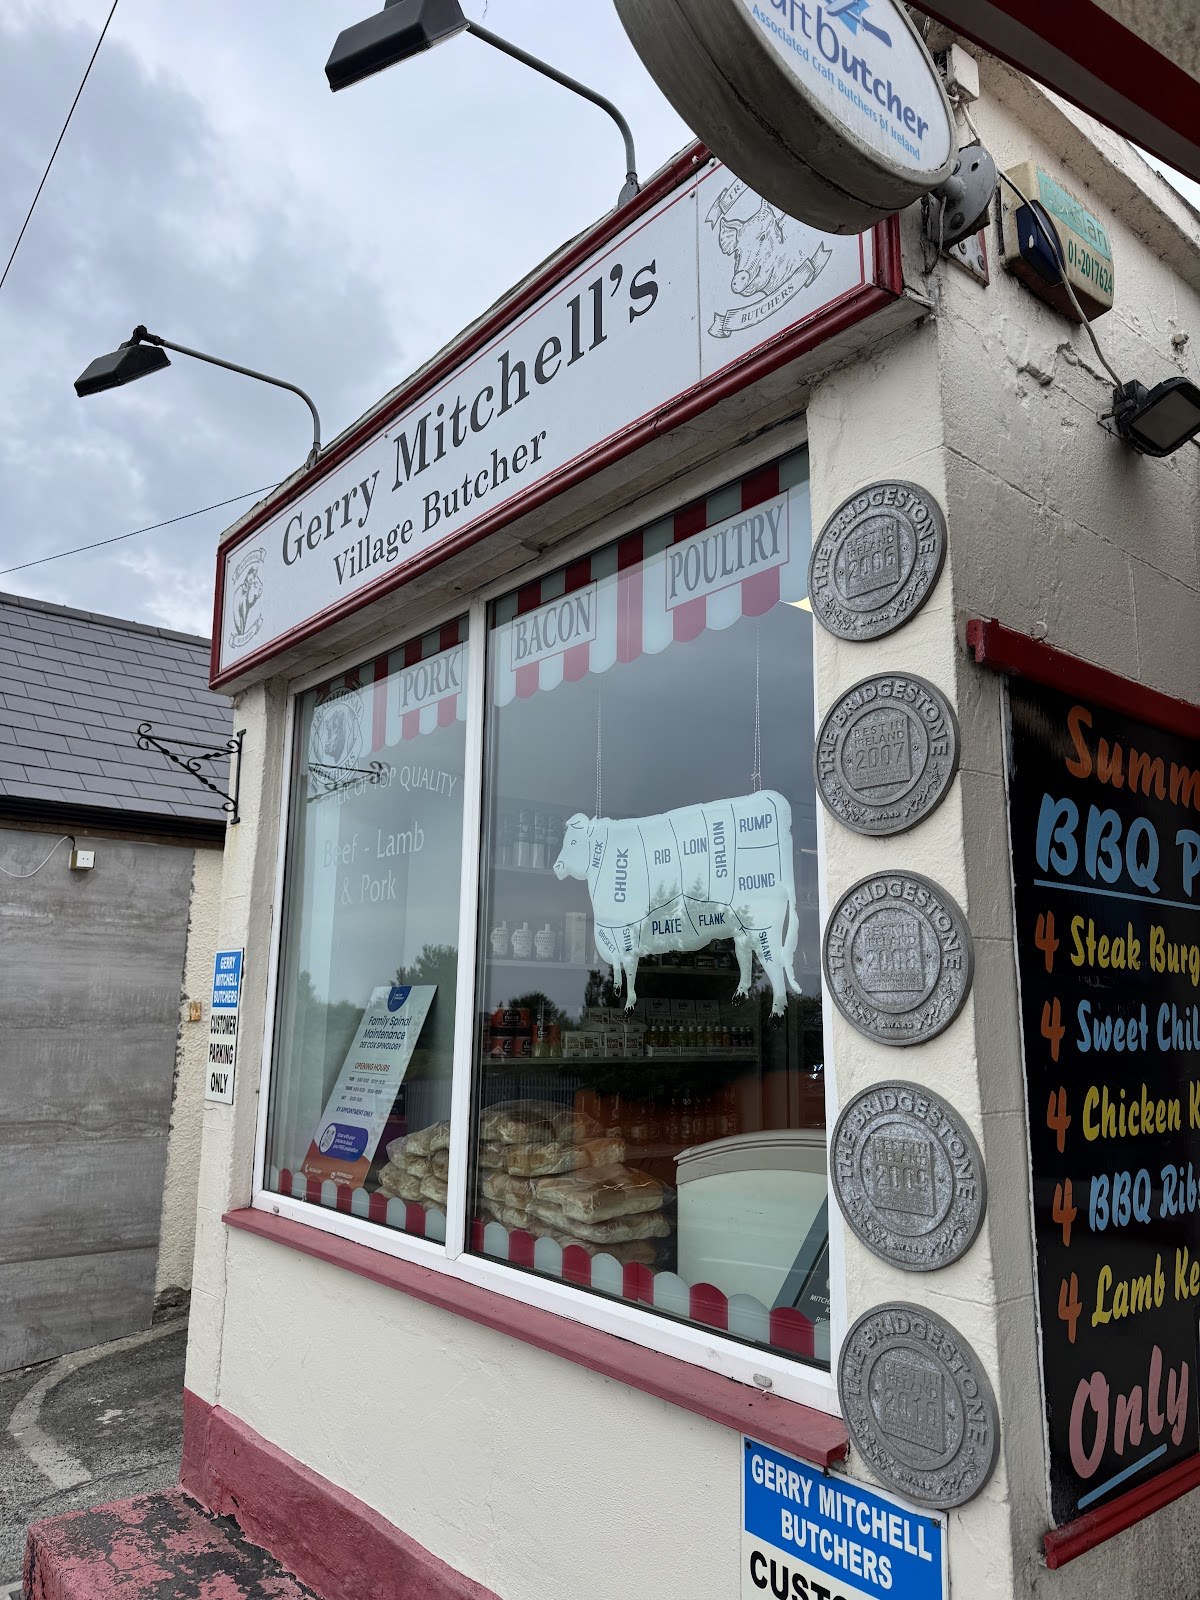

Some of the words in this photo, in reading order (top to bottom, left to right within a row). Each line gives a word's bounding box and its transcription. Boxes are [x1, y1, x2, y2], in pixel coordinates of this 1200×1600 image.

[752, 4, 809, 62] Associated
[811, 56, 836, 85] Craft
[837, 78, 877, 122] Butchers
[879, 117, 889, 132] of
[891, 126, 920, 160] Ireland
[740, 282, 795, 324] BUTCHERS
[281, 468, 380, 566] Gerry
[391, 258, 659, 492] Mitchell's
[333, 517, 414, 586] Village
[421, 430, 547, 533] Butcher
[669, 503, 784, 600] POULTRY
[814, 546, 833, 595] THE
[828, 487, 937, 555] BRIDGESTONE
[848, 545, 896, 579] 2006
[515, 591, 593, 662] BACON
[401, 650, 461, 708] PORK
[820, 729, 839, 780] THE
[831, 679, 949, 757] BRIDGESTONE
[854, 723, 886, 738] BEST
[854, 729, 906, 748] IRELAND
[854, 741, 906, 772] 2007
[400, 765, 458, 798] QUALITY
[739, 813, 773, 834] RUMP
[323, 833, 359, 868] Beef
[376, 821, 425, 859] Lamb
[591, 839, 605, 869] NECK
[654, 848, 672, 866] RIB
[682, 837, 708, 857] LOIN
[712, 821, 728, 879] SIRLOIN
[1035, 792, 1161, 894] BBQ
[361, 869, 397, 903] Pork
[613, 847, 630, 904] CHUCK
[738, 872, 776, 891] ROUND
[652, 918, 682, 936] PLATE
[698, 912, 726, 927] FLANK
[829, 923, 848, 975] THE
[841, 878, 962, 970] BRIDGESTONE
[598, 929, 616, 954] BRISKET
[622, 927, 633, 952] SHIN
[758, 930, 773, 963] SHANK
[1034, 910, 1060, 973] 4
[1071, 914, 1141, 970] Steak
[1149, 924, 1200, 987] Burg
[215, 973, 238, 986] MITCHELL
[220, 956, 236, 970] GERRY
[213, 990, 238, 1004] BUTCHERS
[210, 1015, 237, 1036] CUSTOMER
[362, 1028, 406, 1040] Maintenance
[368, 1015, 390, 1029] Family
[389, 1015, 412, 1029] Spinal
[1040, 996, 1065, 1060] 4
[1076, 1000, 1149, 1052] Sweet
[1156, 1002, 1200, 1052] Chil
[208, 1043, 234, 1065] PARKING
[354, 1062, 374, 1071] OPENING
[373, 1063, 391, 1072] HOURS
[210, 1072, 229, 1094] ONLY
[1046, 1085, 1072, 1153] 4
[1082, 1082, 1182, 1141] Chicken
[836, 1128, 856, 1183] THE
[853, 1091, 976, 1201] BRIDGESTONE
[1052, 1177, 1077, 1247] 4
[1089, 1168, 1152, 1233] BBQ
[1159, 1161, 1200, 1219] Rib
[1057, 1271, 1083, 1344] 4
[1091, 1253, 1166, 1328] Lamb
[1174, 1245, 1200, 1301] Ke
[842, 1344, 868, 1400] THE
[863, 1314, 987, 1446] BRIDGESTONE
[1068, 1344, 1189, 1479] Only
[751, 1453, 813, 1508] GERRY
[818, 1482, 933, 1562] MITCHELL
[781, 1507, 893, 1590] BUTCHERS
[750, 1550, 847, 1600] CUST
